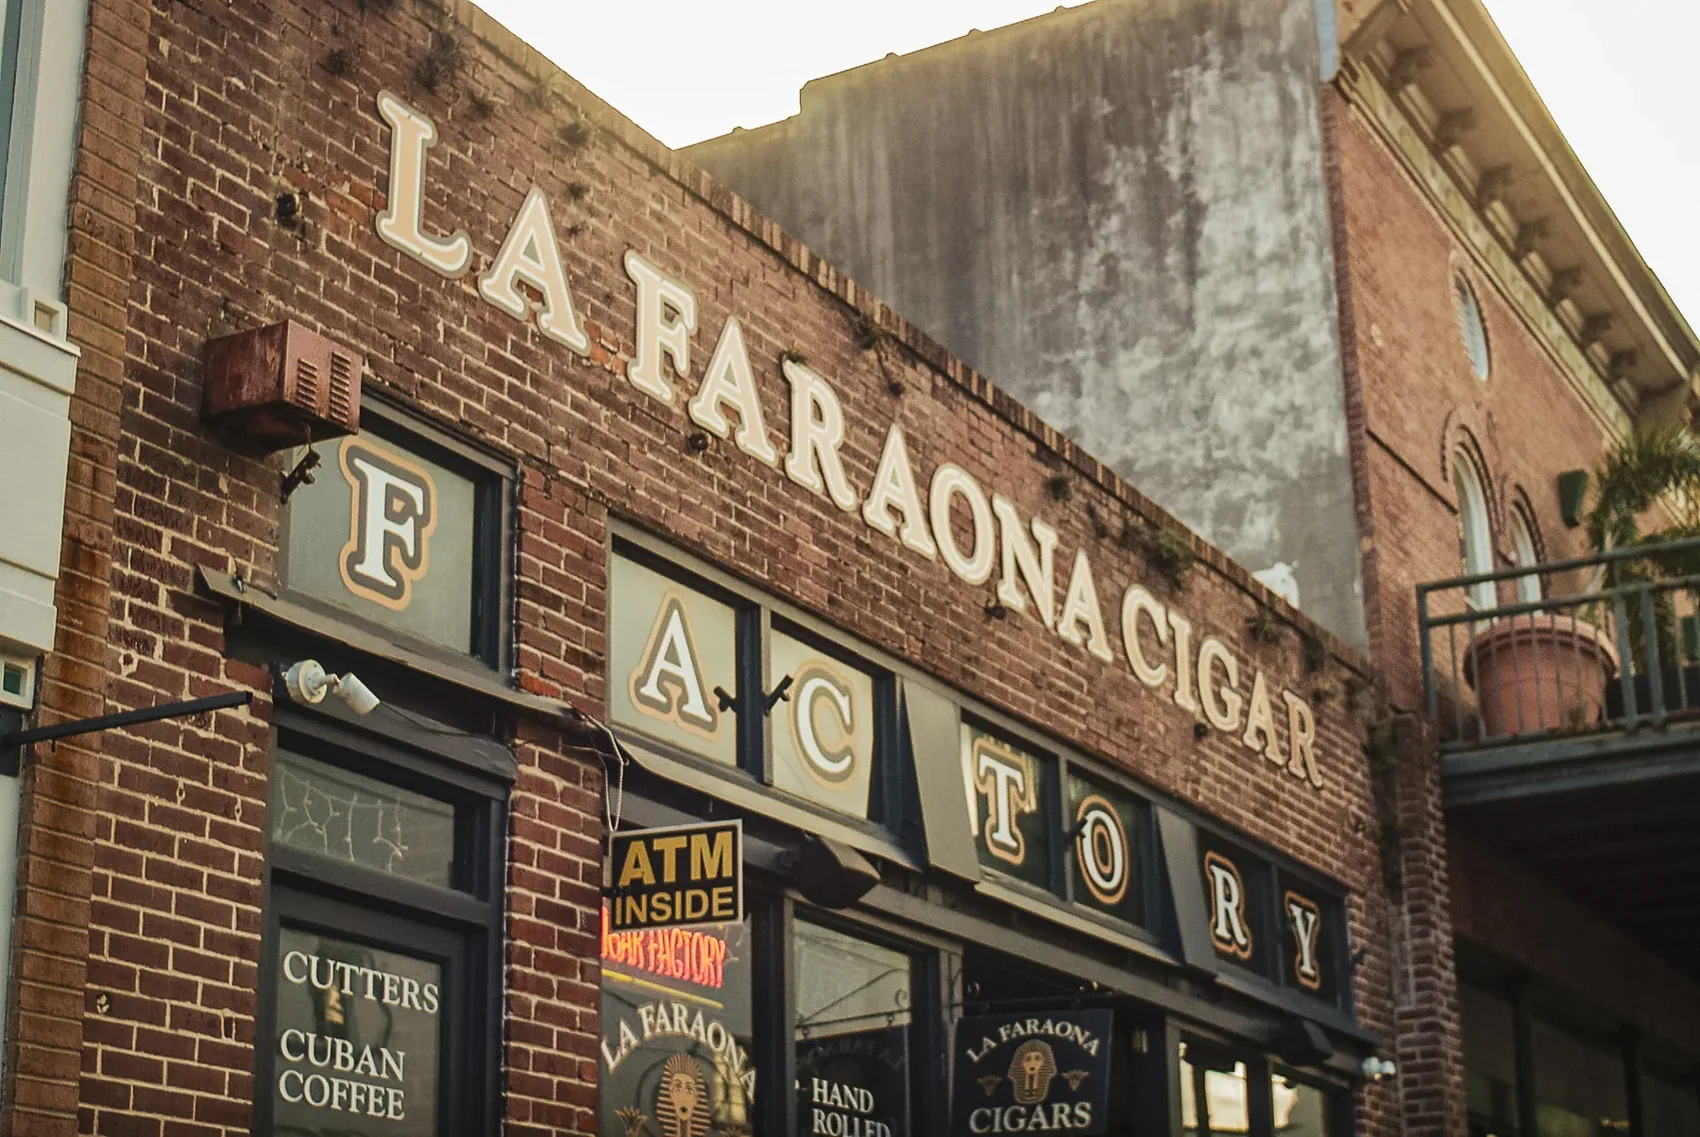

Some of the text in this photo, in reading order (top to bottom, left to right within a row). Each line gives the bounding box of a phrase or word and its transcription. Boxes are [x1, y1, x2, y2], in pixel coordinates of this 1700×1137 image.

[377, 89, 1323, 789] LA FARAONA CIGAR
[339, 434, 1321, 990] FACTORY
[618, 831, 734, 888] ATM
[615, 886, 735, 925] INSIDE
[283, 951, 439, 1014] CUTTERS
[647, 927, 727, 990] FACTORY
[280, 1028, 406, 1083] CUBAN
[600, 1001, 757, 1104] LA FARAONA
[965, 1018, 1101, 1064] LA FARAONA
[278, 1069, 406, 1121] COFFEE
[811, 1077, 875, 1114] HAND
[968, 1101, 1093, 1134] CIGARS
